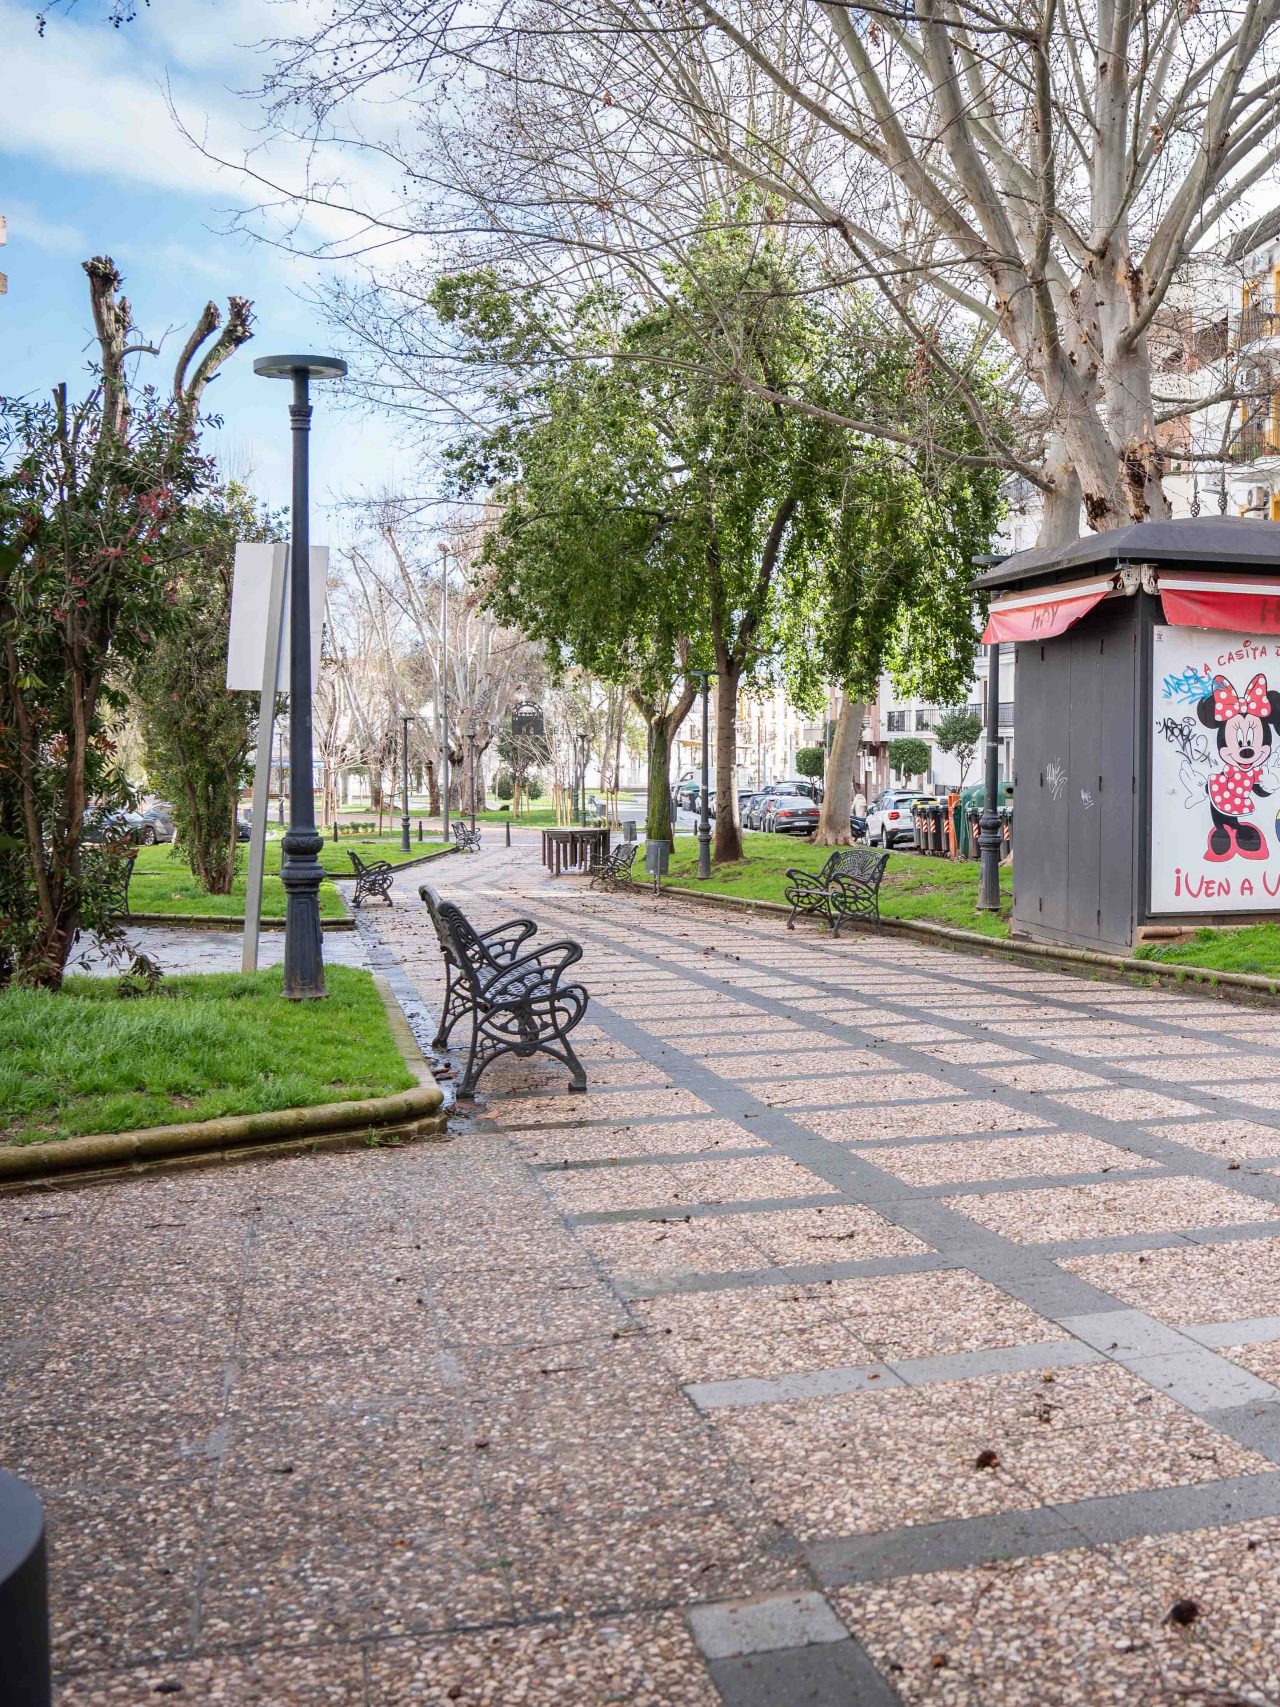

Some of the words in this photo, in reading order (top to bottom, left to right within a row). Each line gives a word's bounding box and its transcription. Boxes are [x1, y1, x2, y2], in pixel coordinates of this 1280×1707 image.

[1218, 640, 1267, 666] CASITA
[1174, 868, 1231, 898] ¡VEN
[1240, 878, 1254, 897] A
